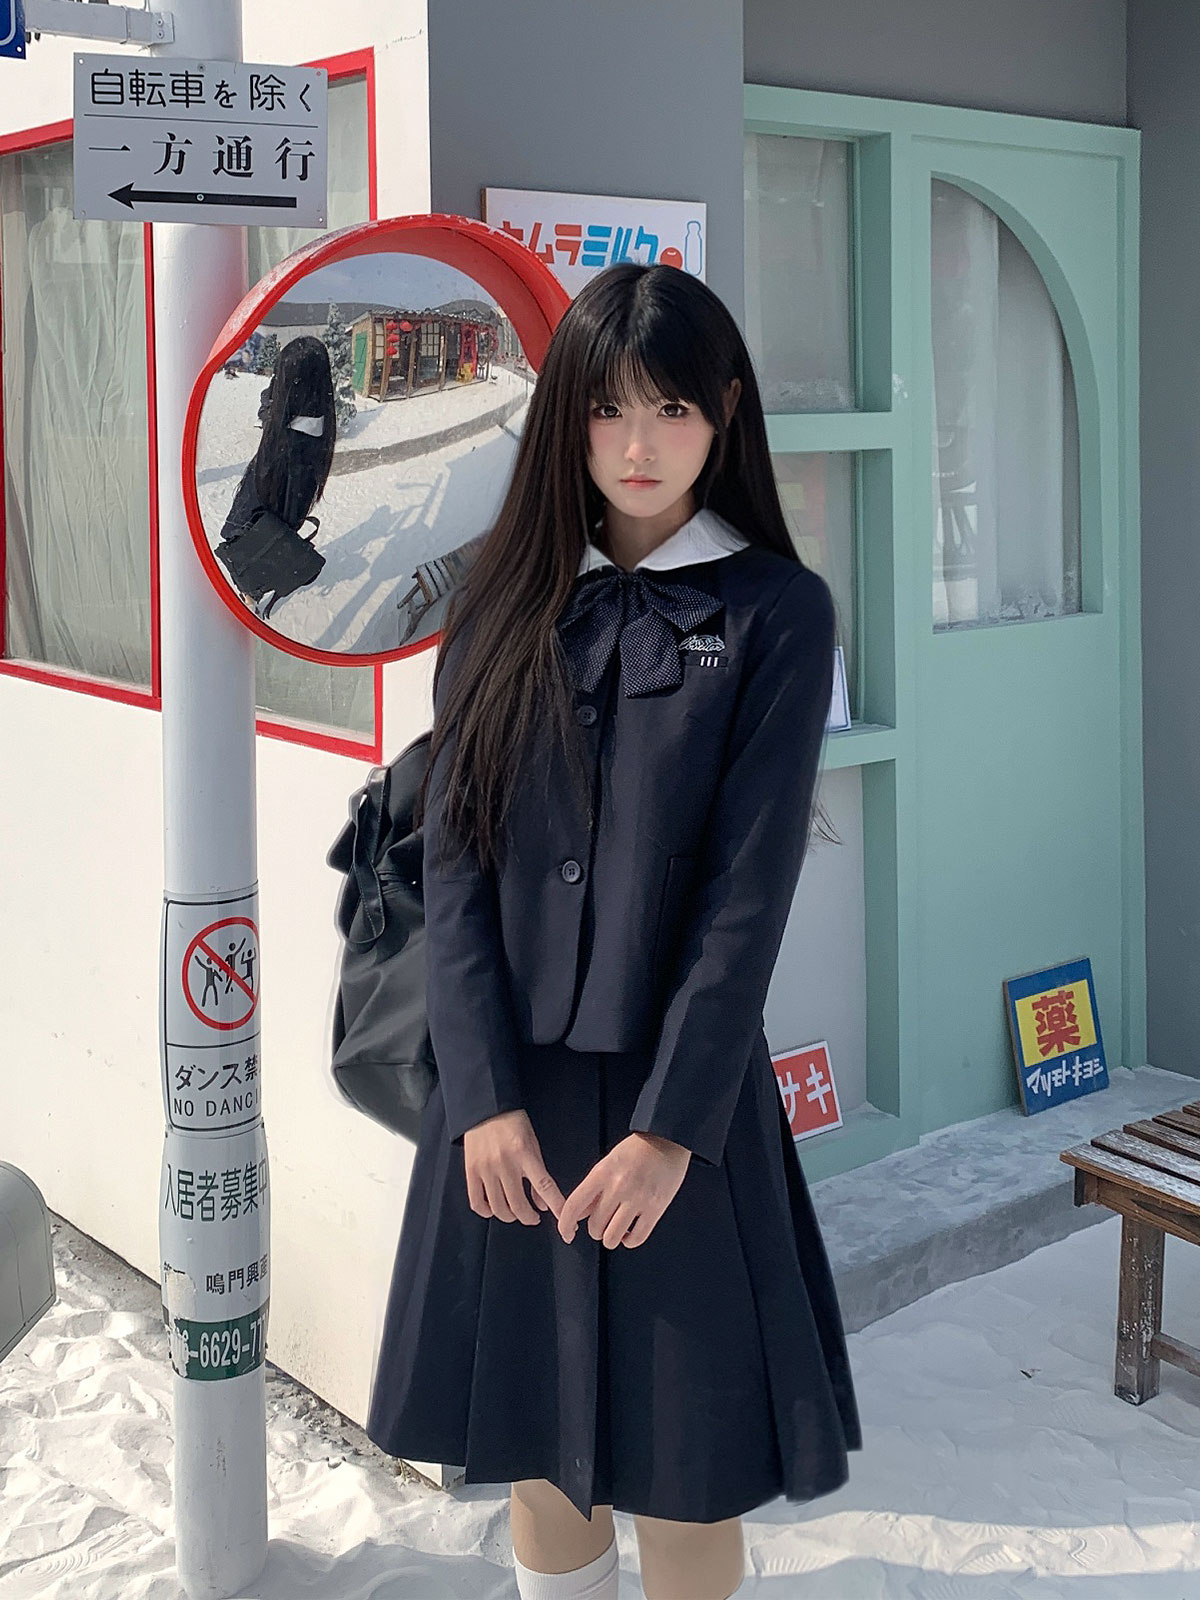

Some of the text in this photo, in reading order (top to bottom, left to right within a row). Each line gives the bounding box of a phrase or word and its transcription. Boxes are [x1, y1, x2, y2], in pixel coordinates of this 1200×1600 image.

[91, 69, 312, 112] 自転車を除く
[89, 132, 316, 181] 一方通行
[1032, 990, 1081, 1057] 薬
[1026, 1056, 1104, 1097] マツモトキヨシ
[174, 1098, 194, 1116] NO
[164, 1153, 267, 1221] 入居者募集中
